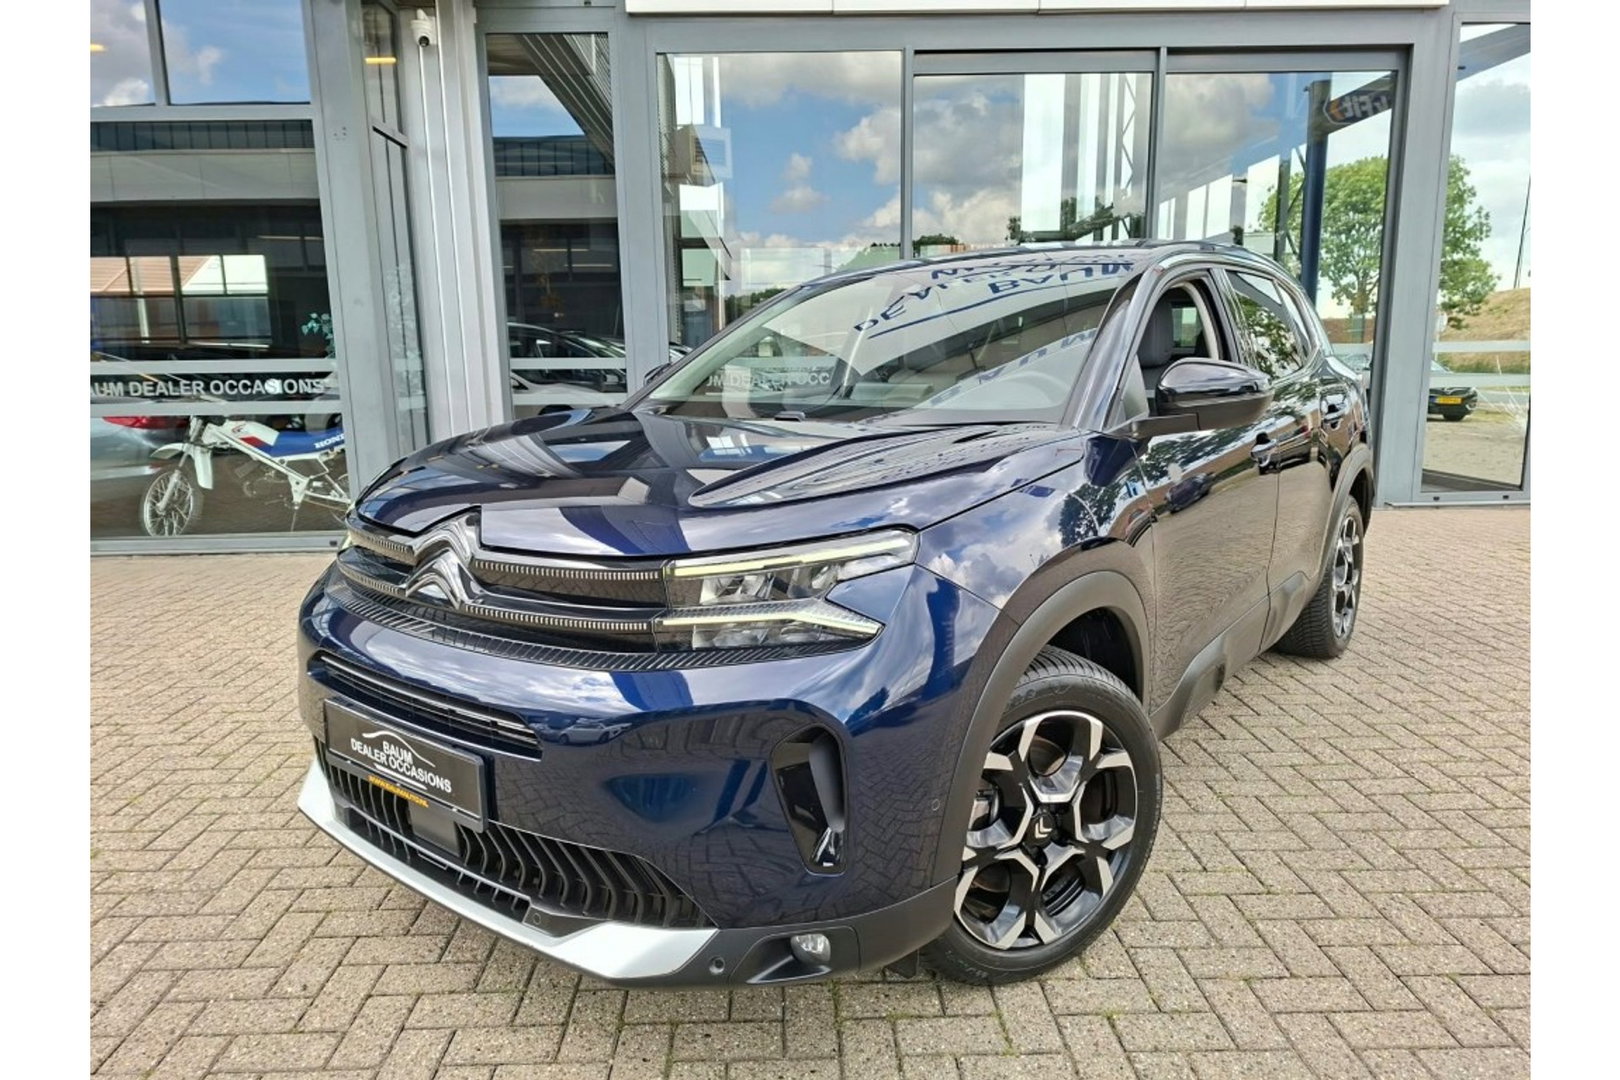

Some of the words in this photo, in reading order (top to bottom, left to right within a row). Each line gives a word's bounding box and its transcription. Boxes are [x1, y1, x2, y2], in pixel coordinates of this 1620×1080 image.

[129, 380, 205, 396] DEALER
[209, 378, 324, 395] OCCASIONS
[382, 741, 414, 765] BAUM
[350, 738, 387, 765] DEALER
[388, 757, 452, 793] OCCASIONS
